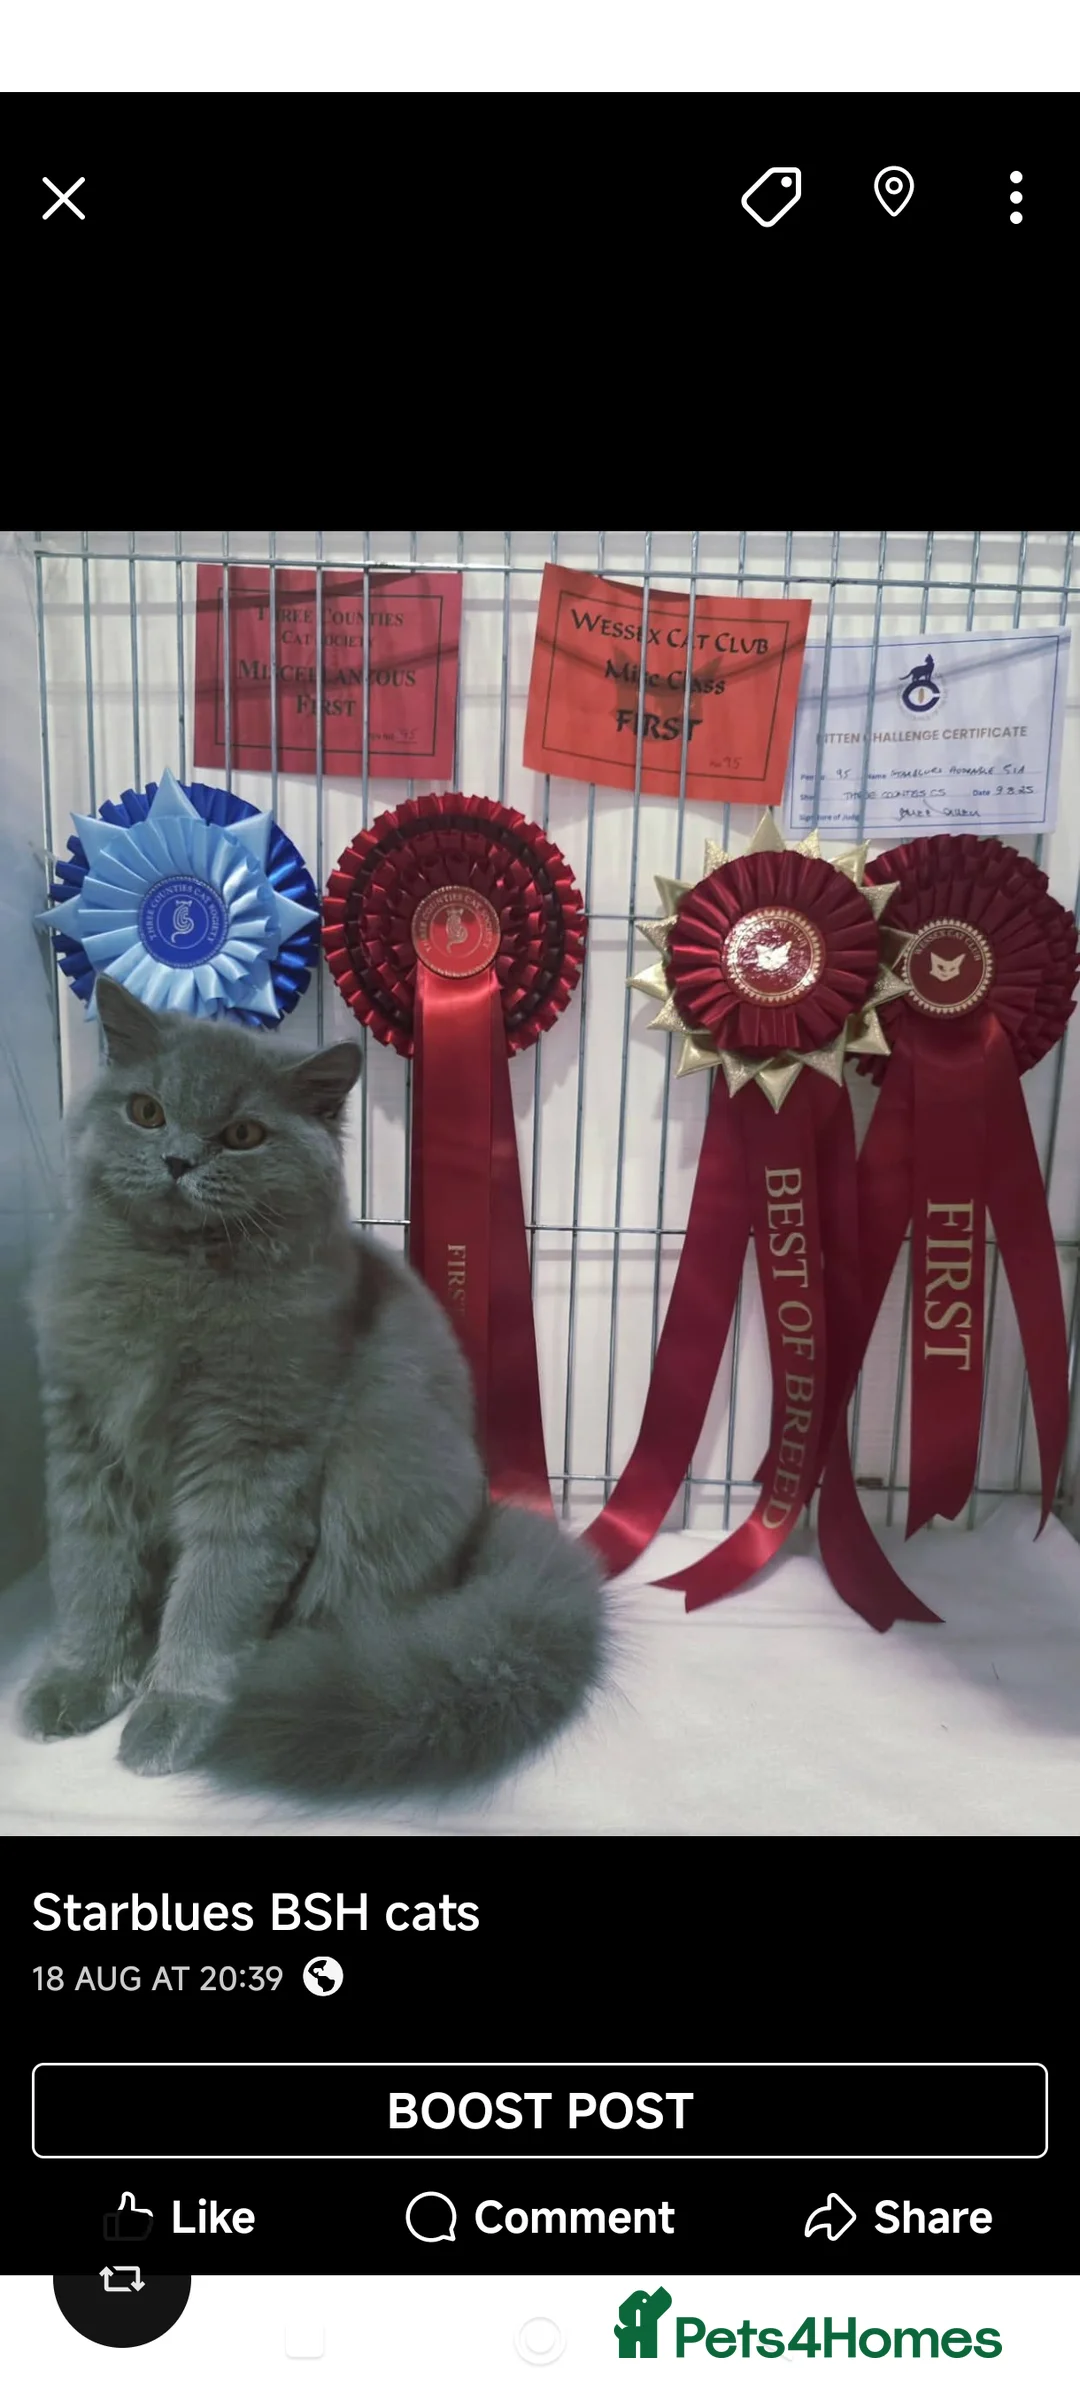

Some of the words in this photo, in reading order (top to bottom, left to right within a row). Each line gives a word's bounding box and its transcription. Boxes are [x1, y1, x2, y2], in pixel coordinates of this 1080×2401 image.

[281, 630, 311, 646] CAT
[317, 633, 374, 649] OCIETY
[570, 608, 661, 646] WESSEX
[714, 632, 770, 656] CLUB
[237, 658, 417, 688] MICELLANOUS
[296, 693, 357, 717] FIRST
[616, 708, 704, 742] FIRST
[816, 732, 861, 745] ITTEN
[863, 729, 940, 745] HALLENGE
[941, 725, 1029, 741] CERTIFICATE
[764, 1165, 809, 1289] BEST
[447, 1243, 467, 1317] FIRS
[924, 1198, 975, 1372] FIRST
[777, 1300, 815, 1362] OF
[761, 1371, 815, 1530] BREED
